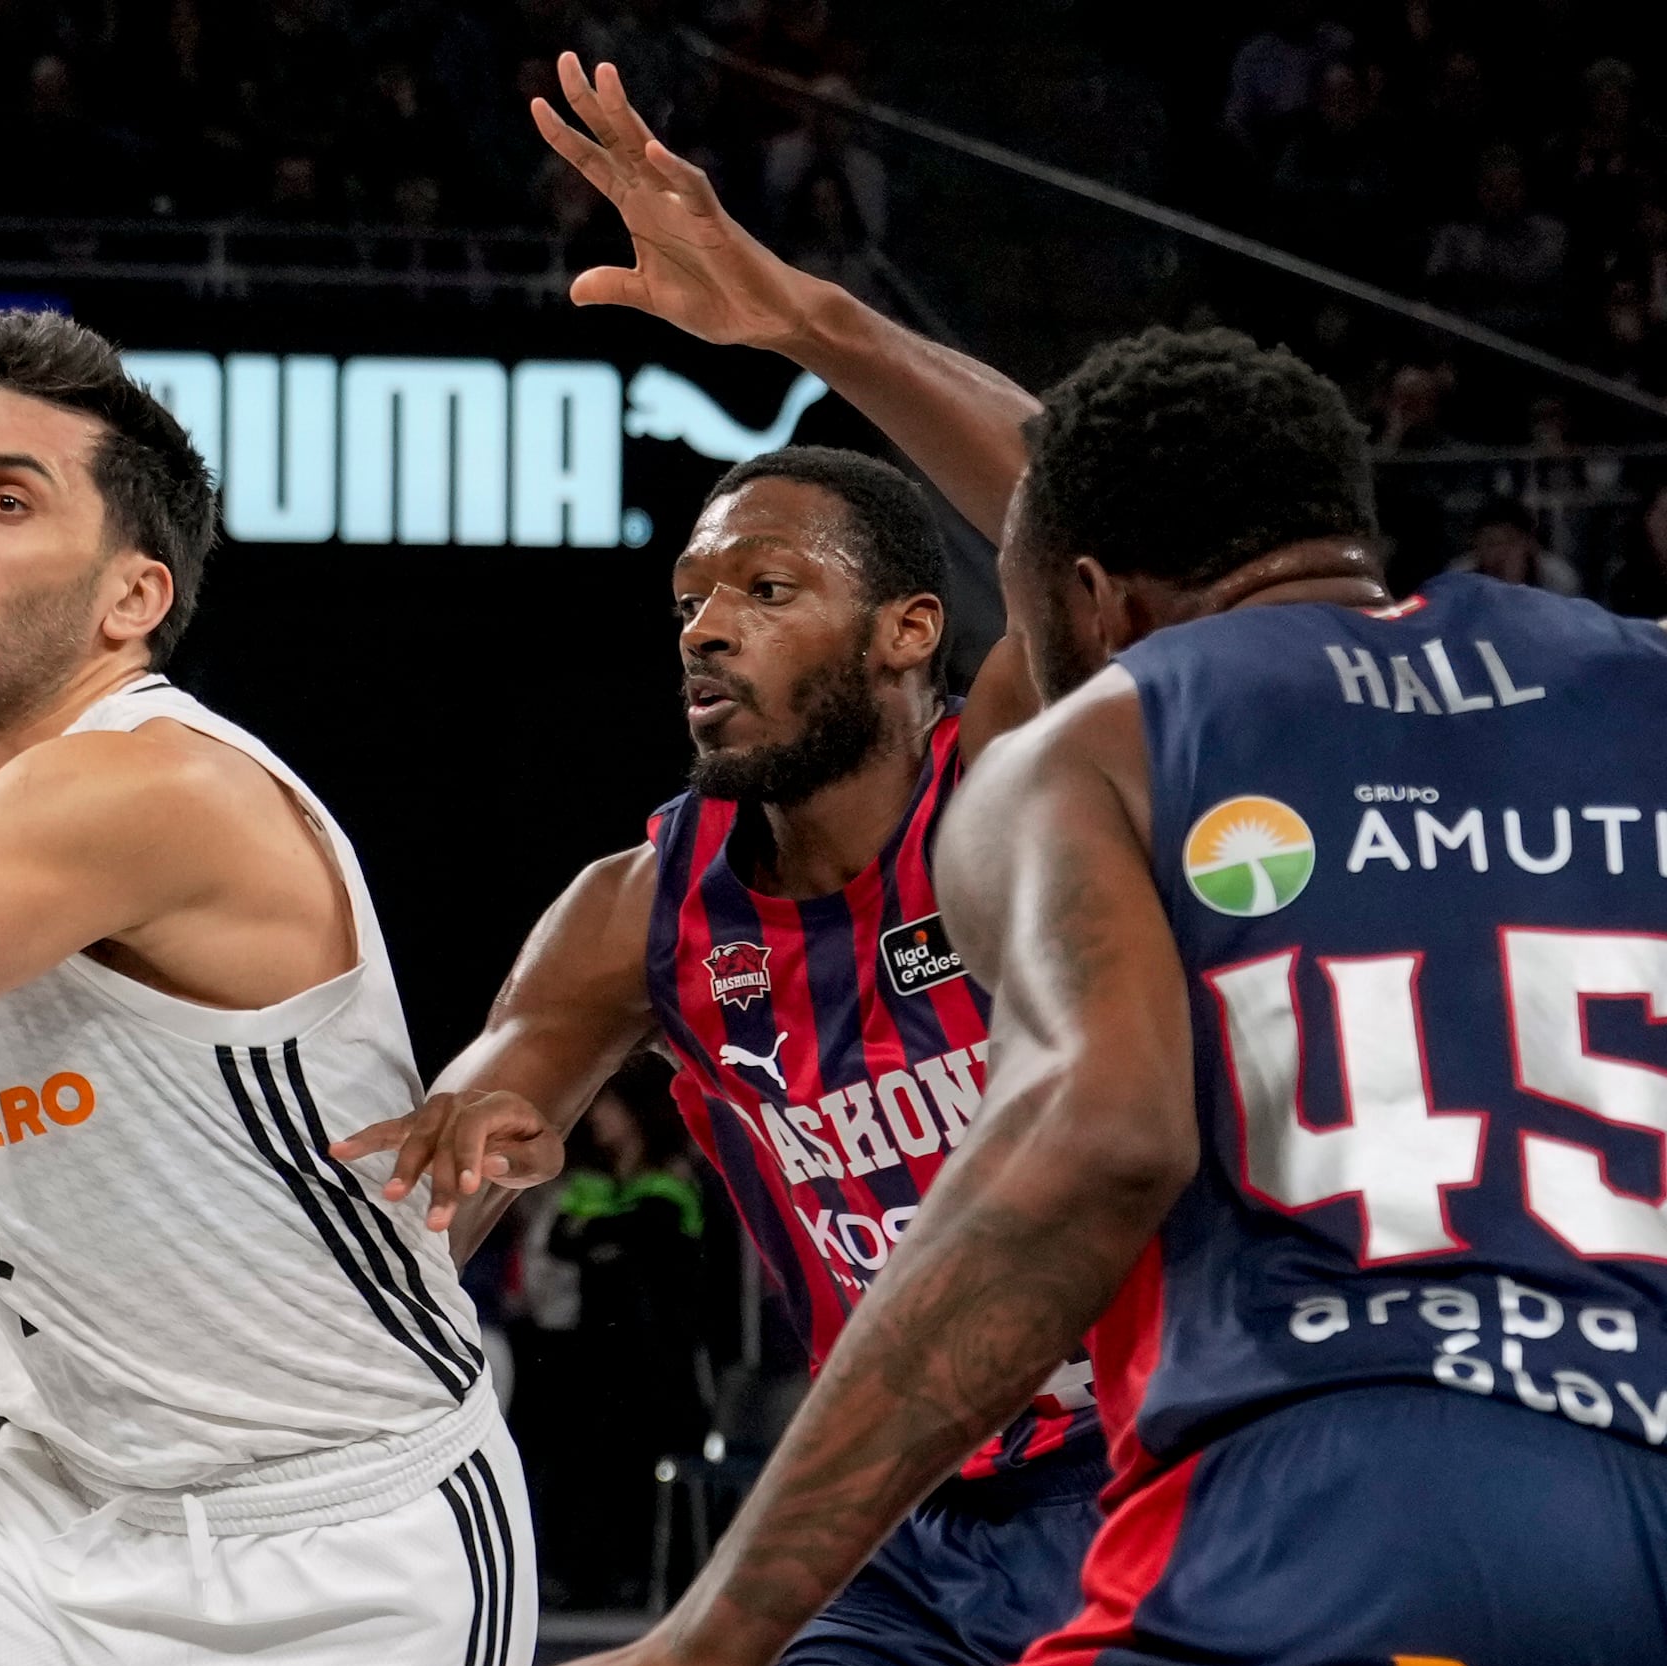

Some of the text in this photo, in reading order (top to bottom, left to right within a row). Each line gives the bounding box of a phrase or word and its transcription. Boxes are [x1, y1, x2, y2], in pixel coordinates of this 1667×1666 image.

[1324, 638, 1547, 715] HALL
[1353, 783, 1441, 805] GRUPO
[714, 970, 767, 994] BASKONIA
[894, 943, 929, 968] liga
[730, 1040, 988, 1186] ASKON
[1202, 926, 1667, 1268] 45
[1288, 1275, 1639, 1354] araba
